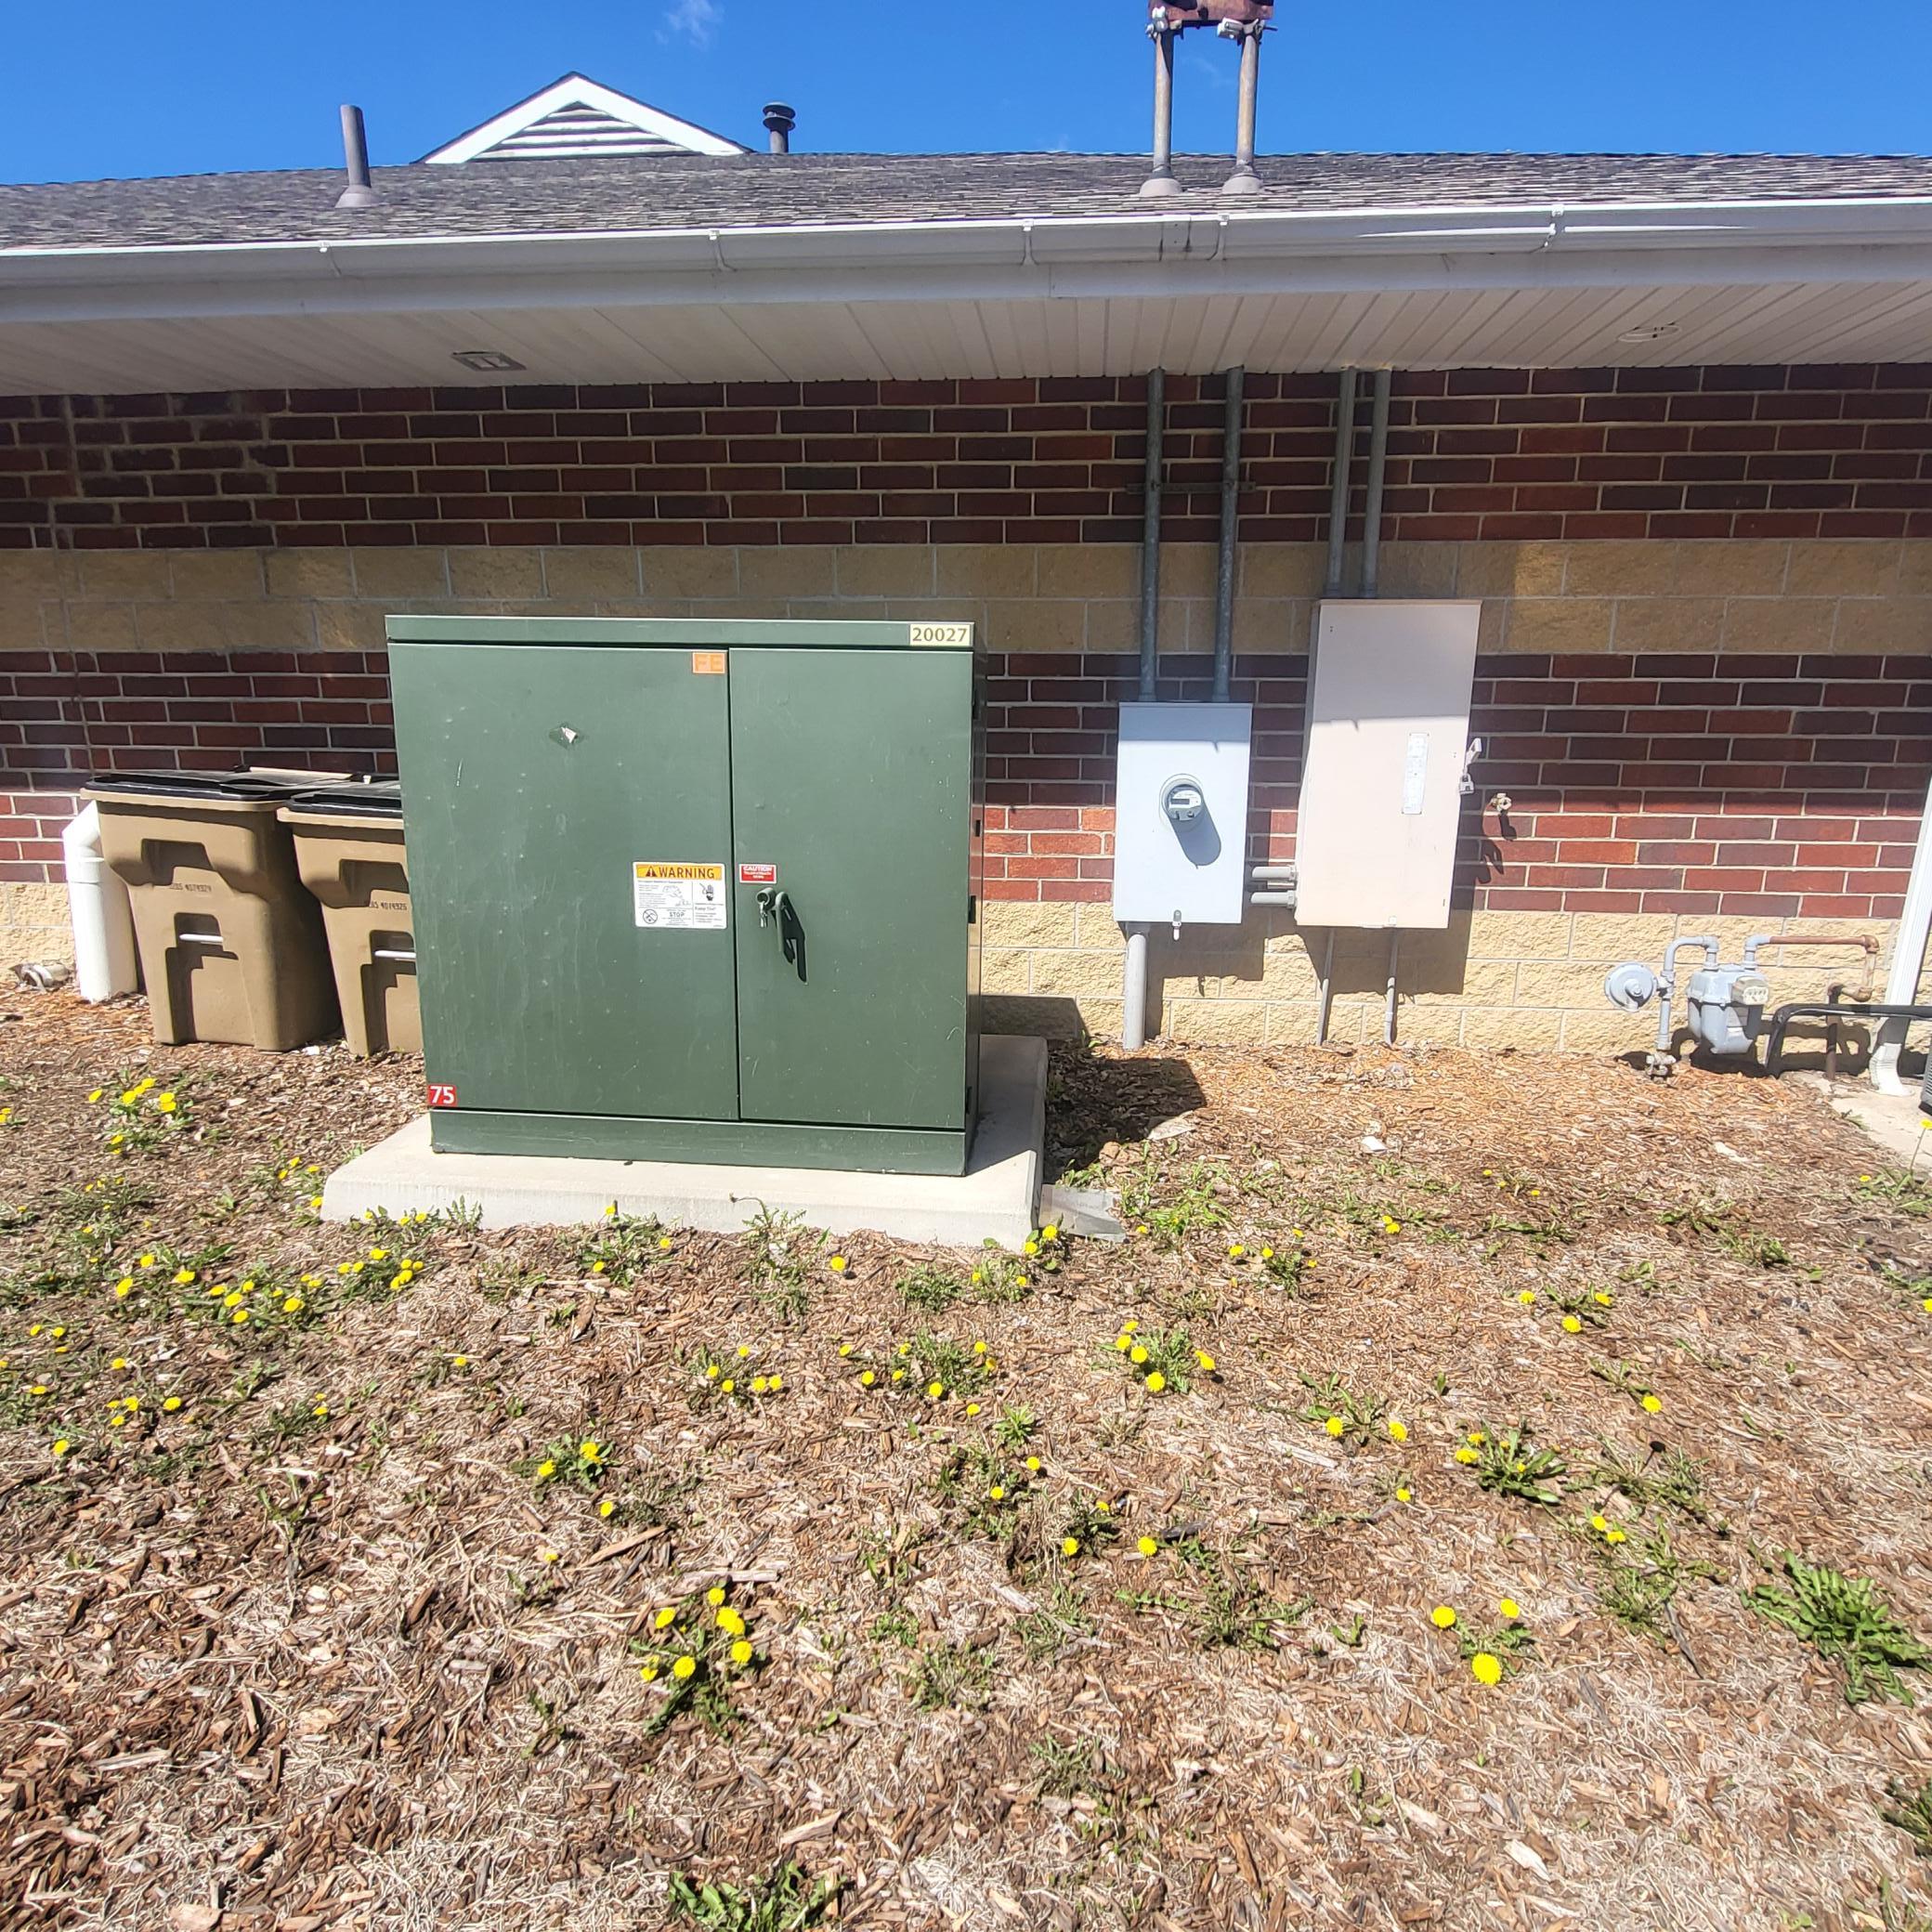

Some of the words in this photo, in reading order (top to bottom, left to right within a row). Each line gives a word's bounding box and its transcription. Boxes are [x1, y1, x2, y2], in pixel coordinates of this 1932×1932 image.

[912, 627, 968, 642] 20027
[659, 867, 715, 879] WARNING
[429, 1085, 455, 1104] 75
